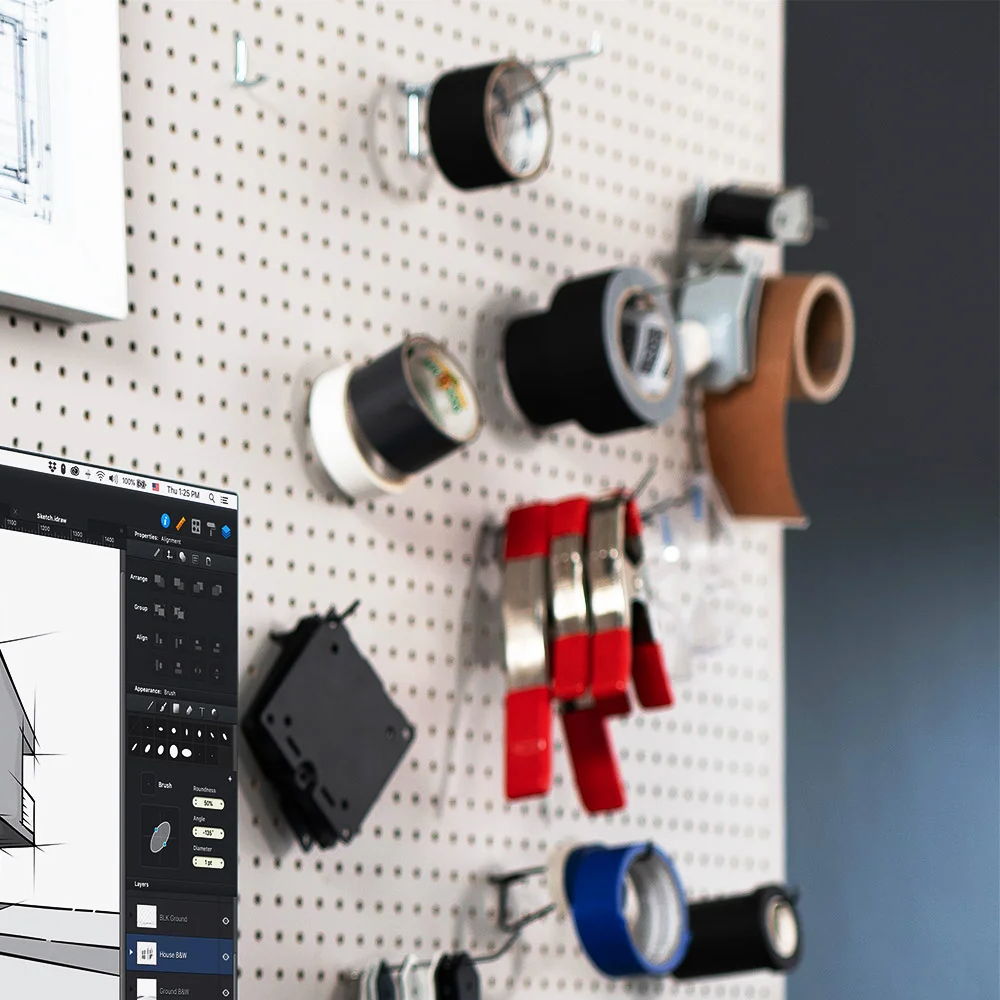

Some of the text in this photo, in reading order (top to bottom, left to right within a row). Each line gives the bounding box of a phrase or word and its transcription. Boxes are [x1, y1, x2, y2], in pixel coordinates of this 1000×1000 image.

[122, 477, 136, 486] 100%
[167, 486, 200, 498] Thu 1:25 PM
[36, 513, 67, 524] Sketch.idraw
[134, 531, 182, 545] Properties: Alignment
[130, 574, 148, 583] Arrange
[134, 604, 148, 612] Group
[134, 685, 162, 695] Appearance:
